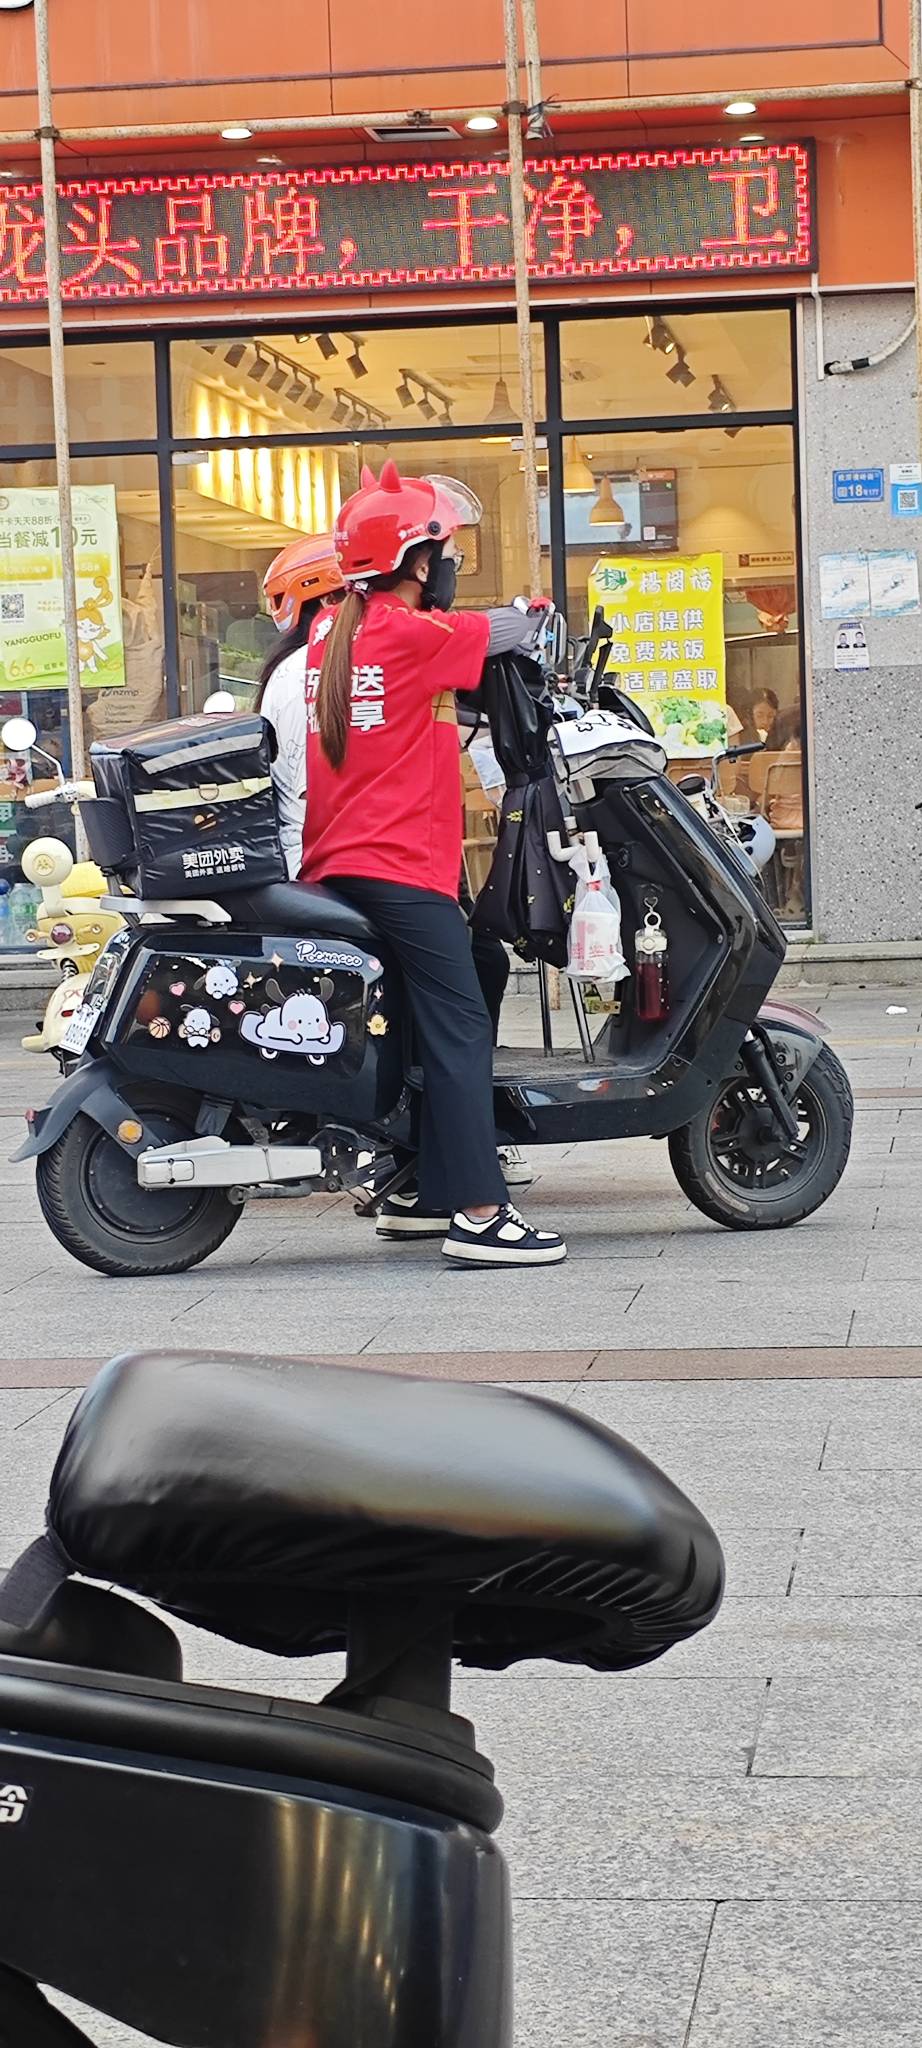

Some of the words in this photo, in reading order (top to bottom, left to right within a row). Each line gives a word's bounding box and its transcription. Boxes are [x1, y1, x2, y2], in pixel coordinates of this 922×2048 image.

[610, 609, 704, 633] 小店提供
[5, 632, 61, 647] YANGGUOFU
[611, 639, 705, 664] 免费米饭
[624, 669, 719, 693] 适量盛取
[182, 846, 244, 870] 美团外卖
